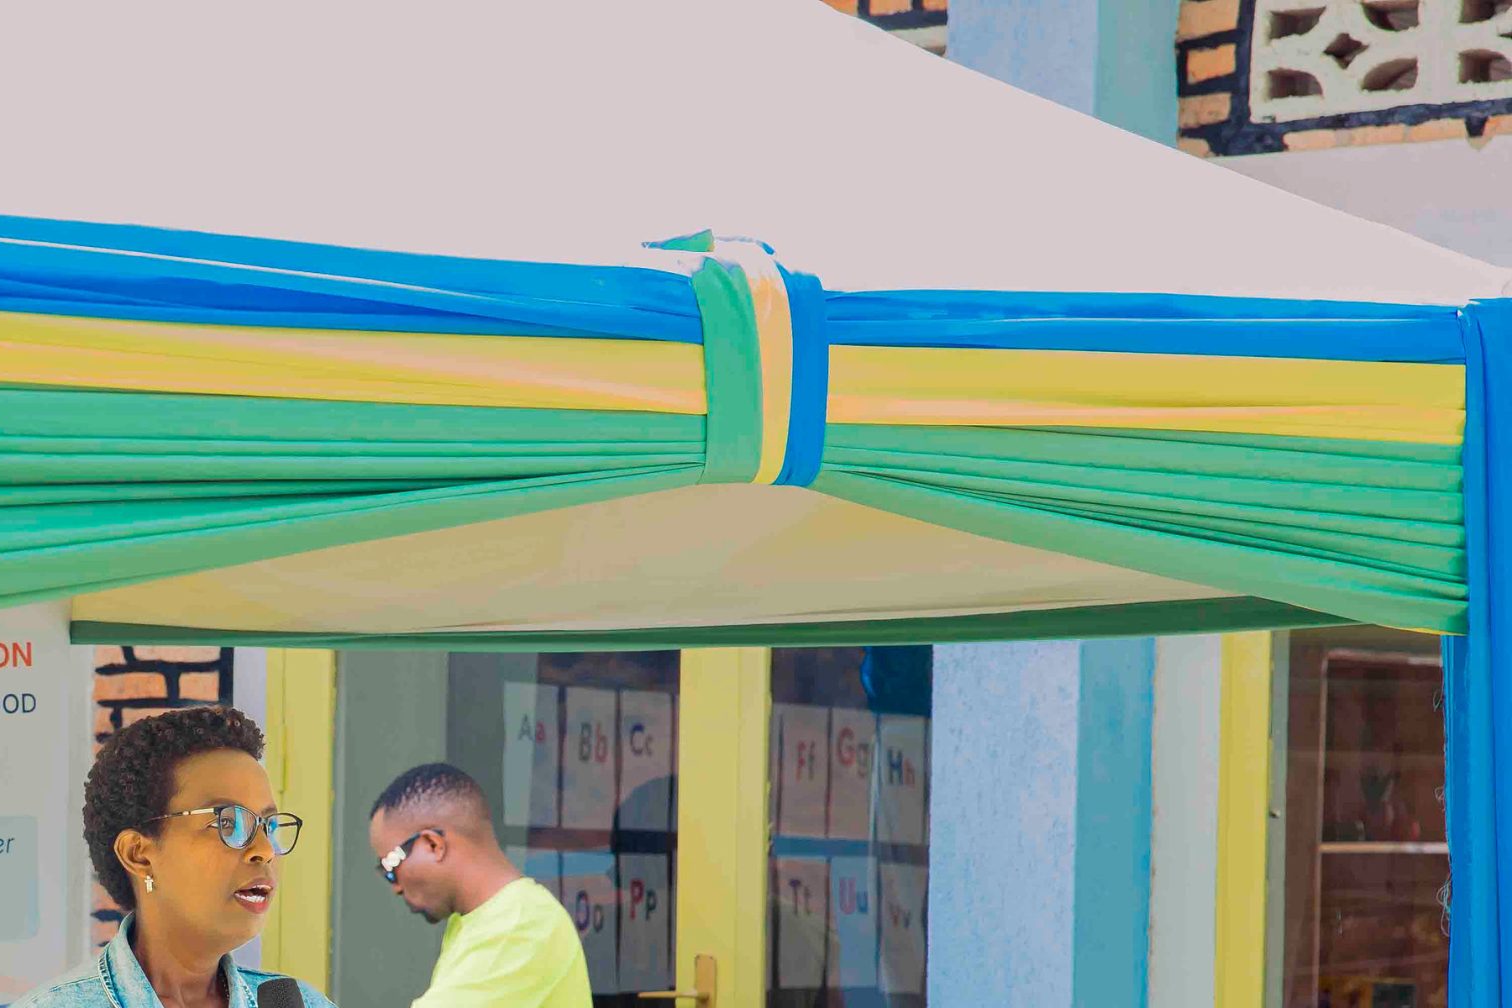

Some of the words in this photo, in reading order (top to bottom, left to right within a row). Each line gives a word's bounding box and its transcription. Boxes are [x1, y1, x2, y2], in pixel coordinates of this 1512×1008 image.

[518, 713, 546, 744] Aa
[578, 723, 609, 763] Bb
[630, 722, 654, 757] Cc
[838, 726, 869, 779] Gg
[889, 745, 915, 789] Hh
[629, 879, 657, 922] Pp
[838, 876, 868, 915] Uu
